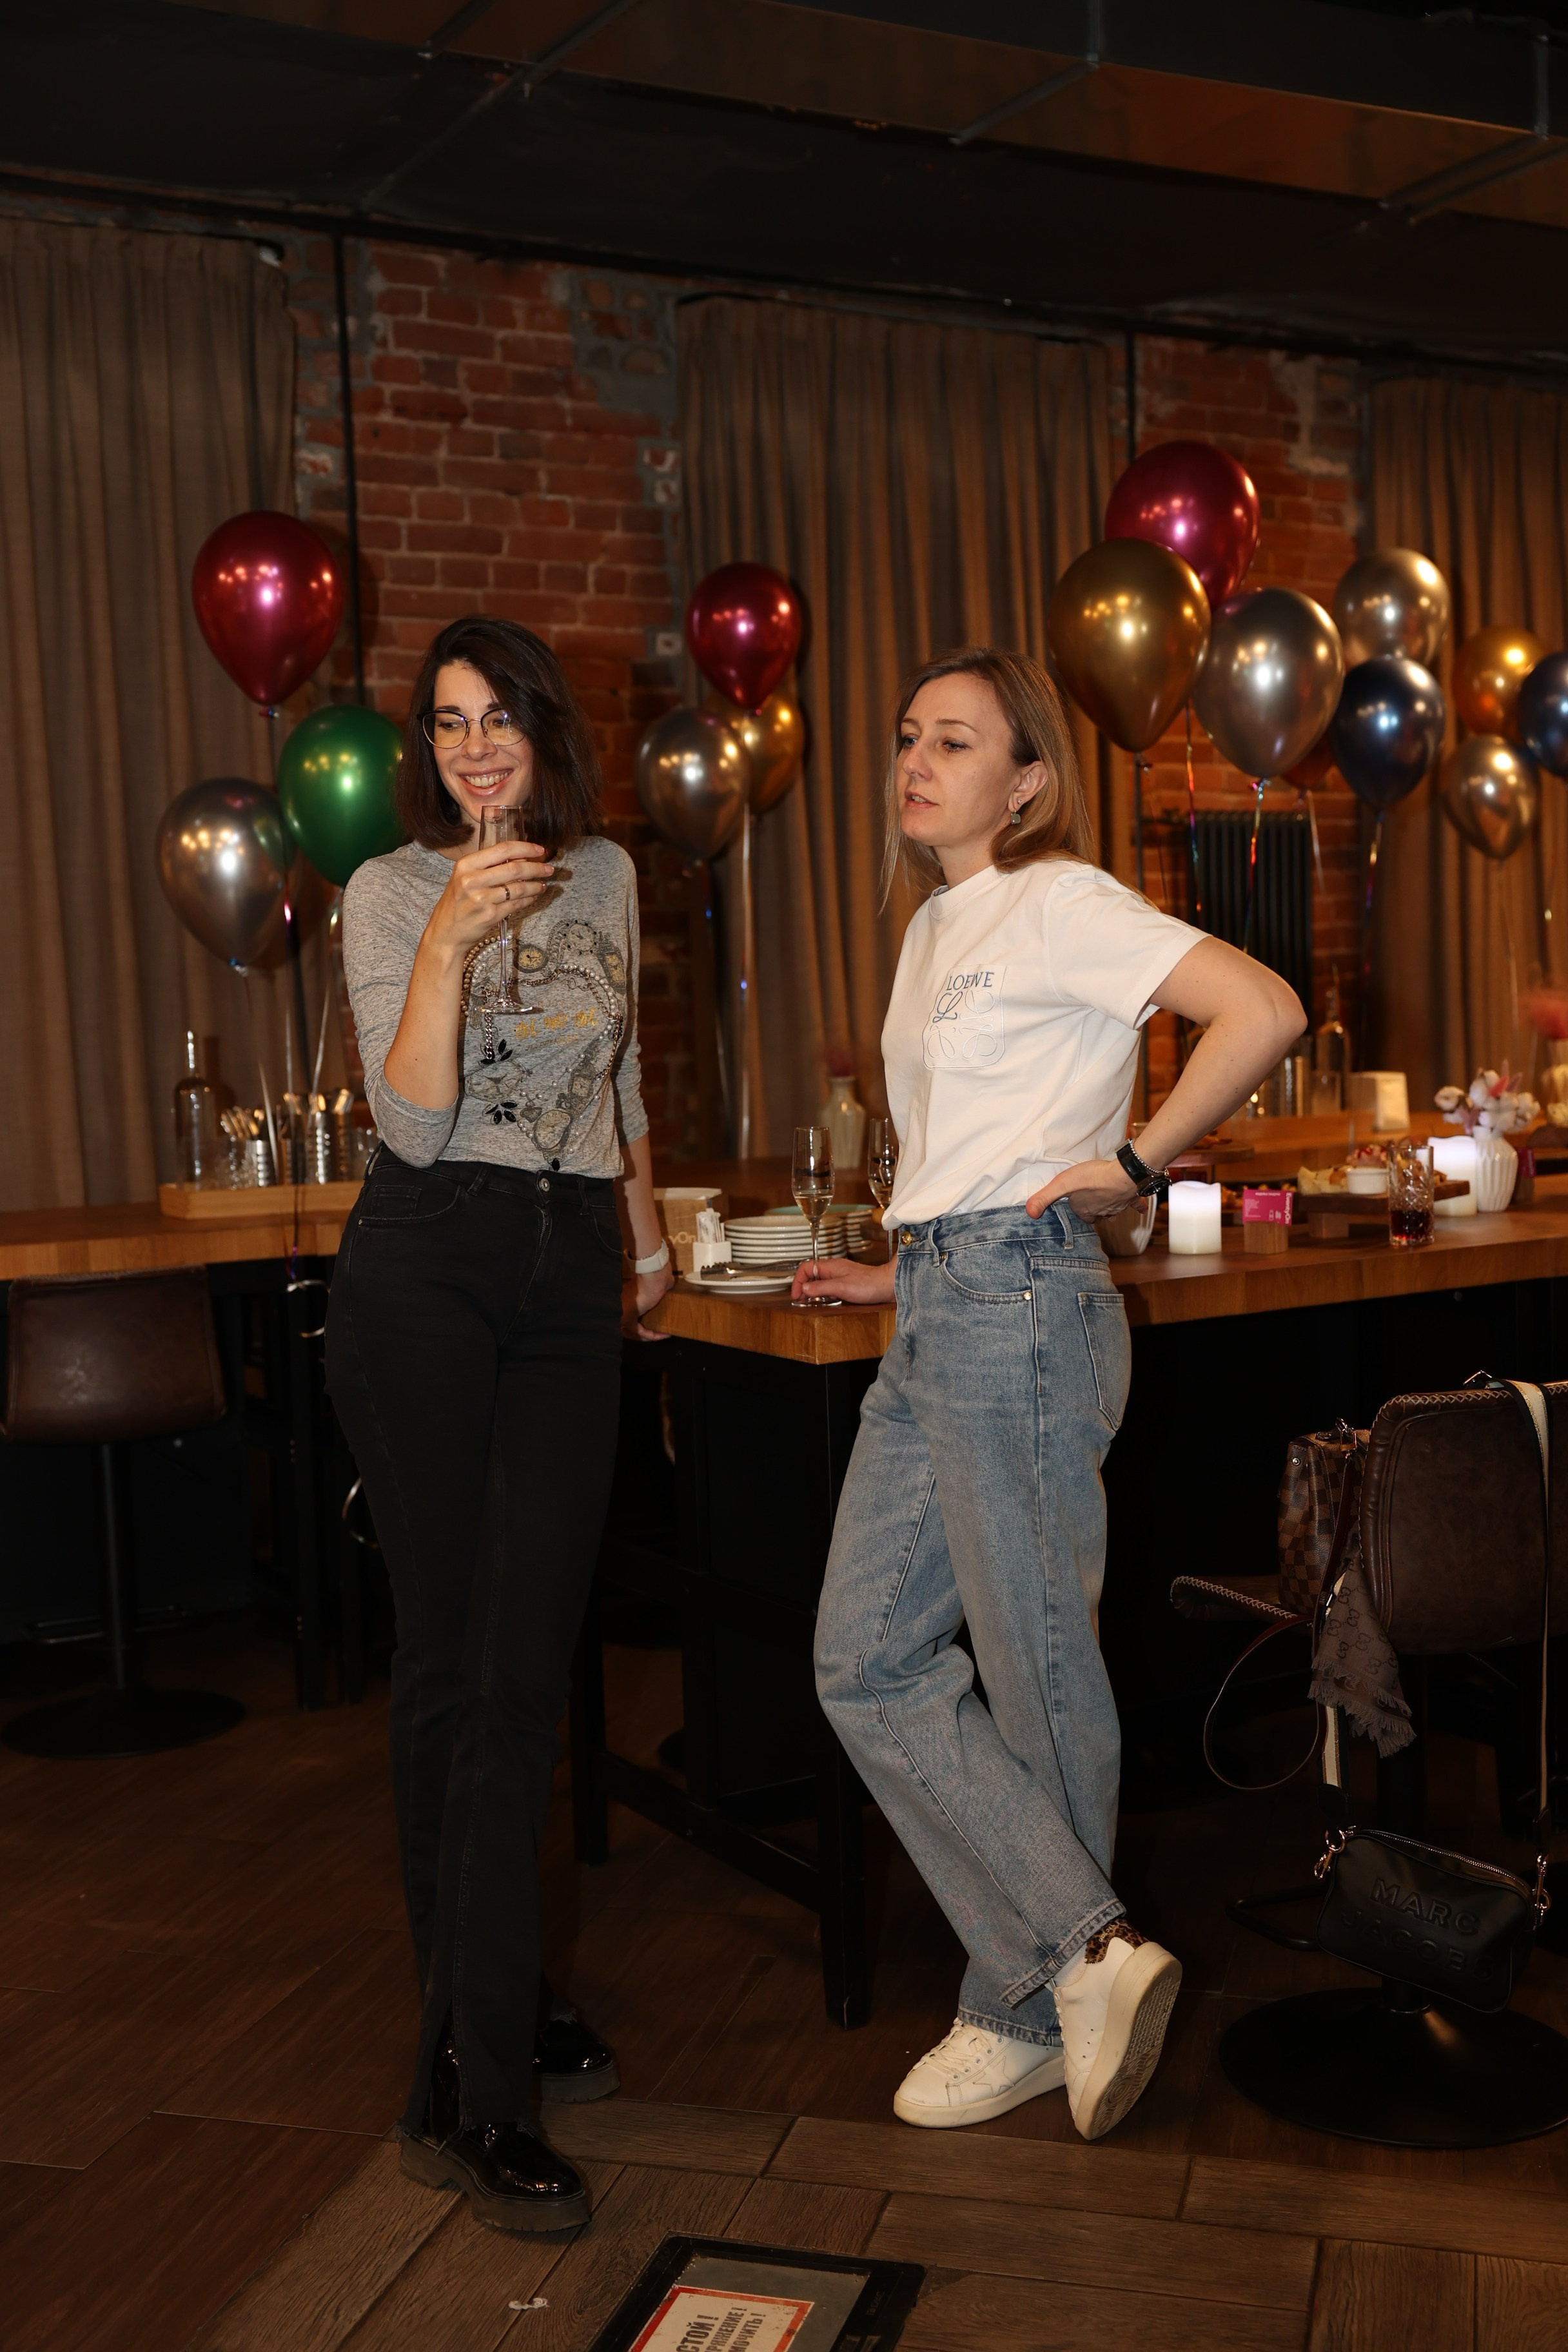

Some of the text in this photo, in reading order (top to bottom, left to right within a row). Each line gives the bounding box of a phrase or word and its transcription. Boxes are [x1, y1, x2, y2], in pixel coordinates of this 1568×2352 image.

[946, 971, 994, 990] LOEWE
[1369, 1877, 1480, 1936] MARC
[704, 2307, 747, 2352] РЯЖЕНИЕ!
